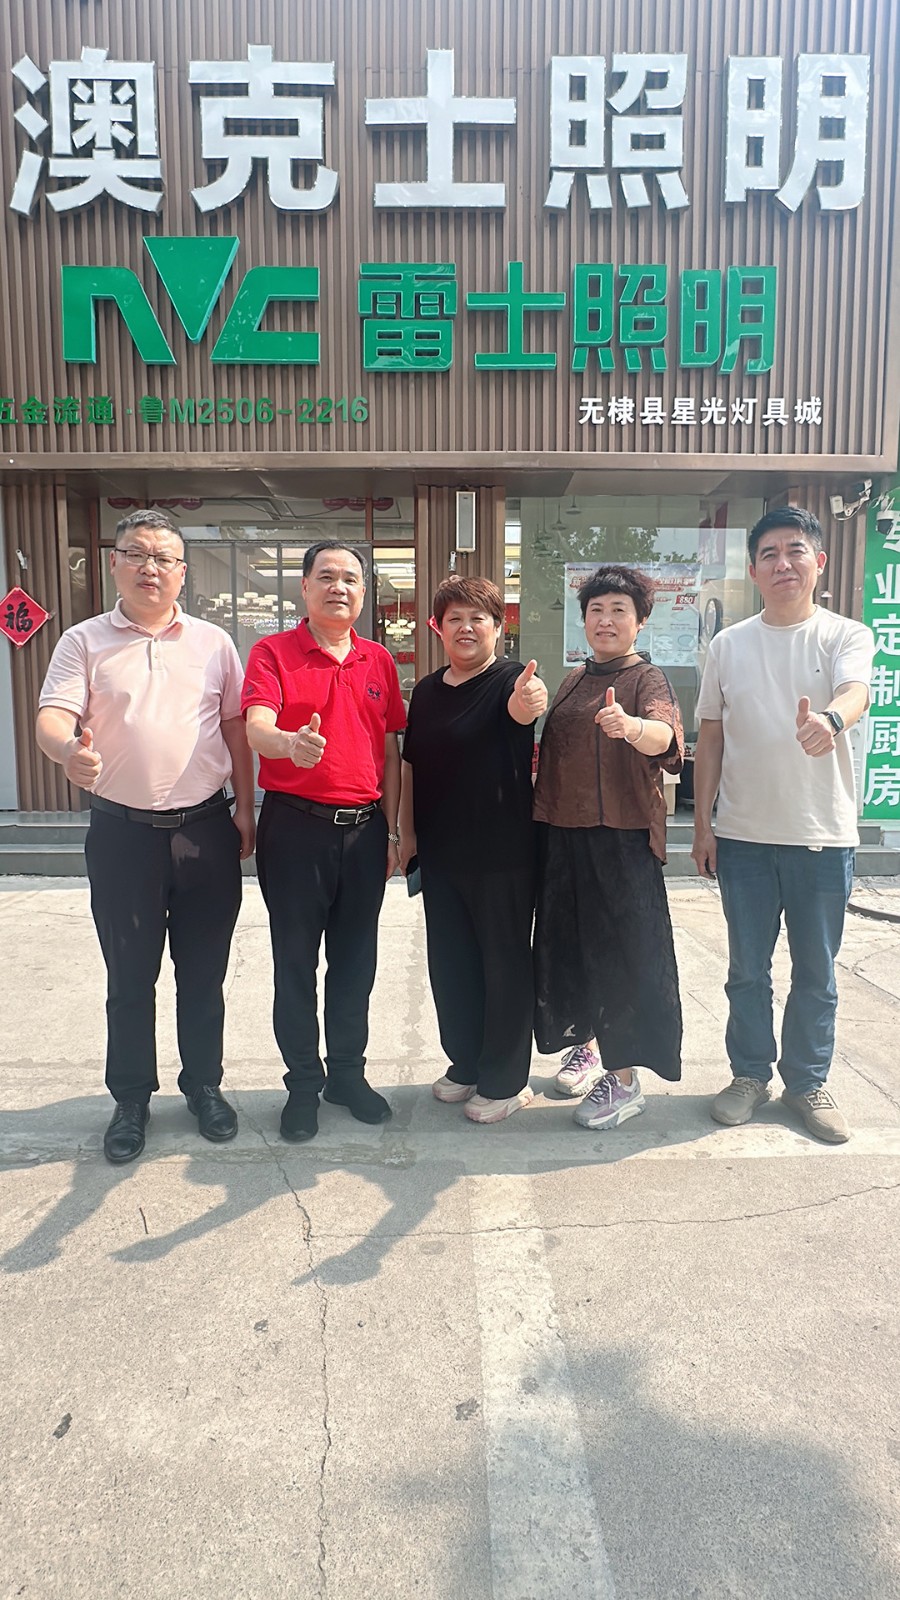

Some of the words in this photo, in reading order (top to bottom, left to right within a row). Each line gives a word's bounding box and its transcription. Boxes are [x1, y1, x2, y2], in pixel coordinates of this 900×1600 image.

[9, 44, 872, 215] 澳克士照明
[61, 236, 321, 365] NVC
[357, 261, 779, 375] 雷士照明
[578, 396, 823, 426] 无棣县星光灯具城
[4, 601, 33, 632] 福
